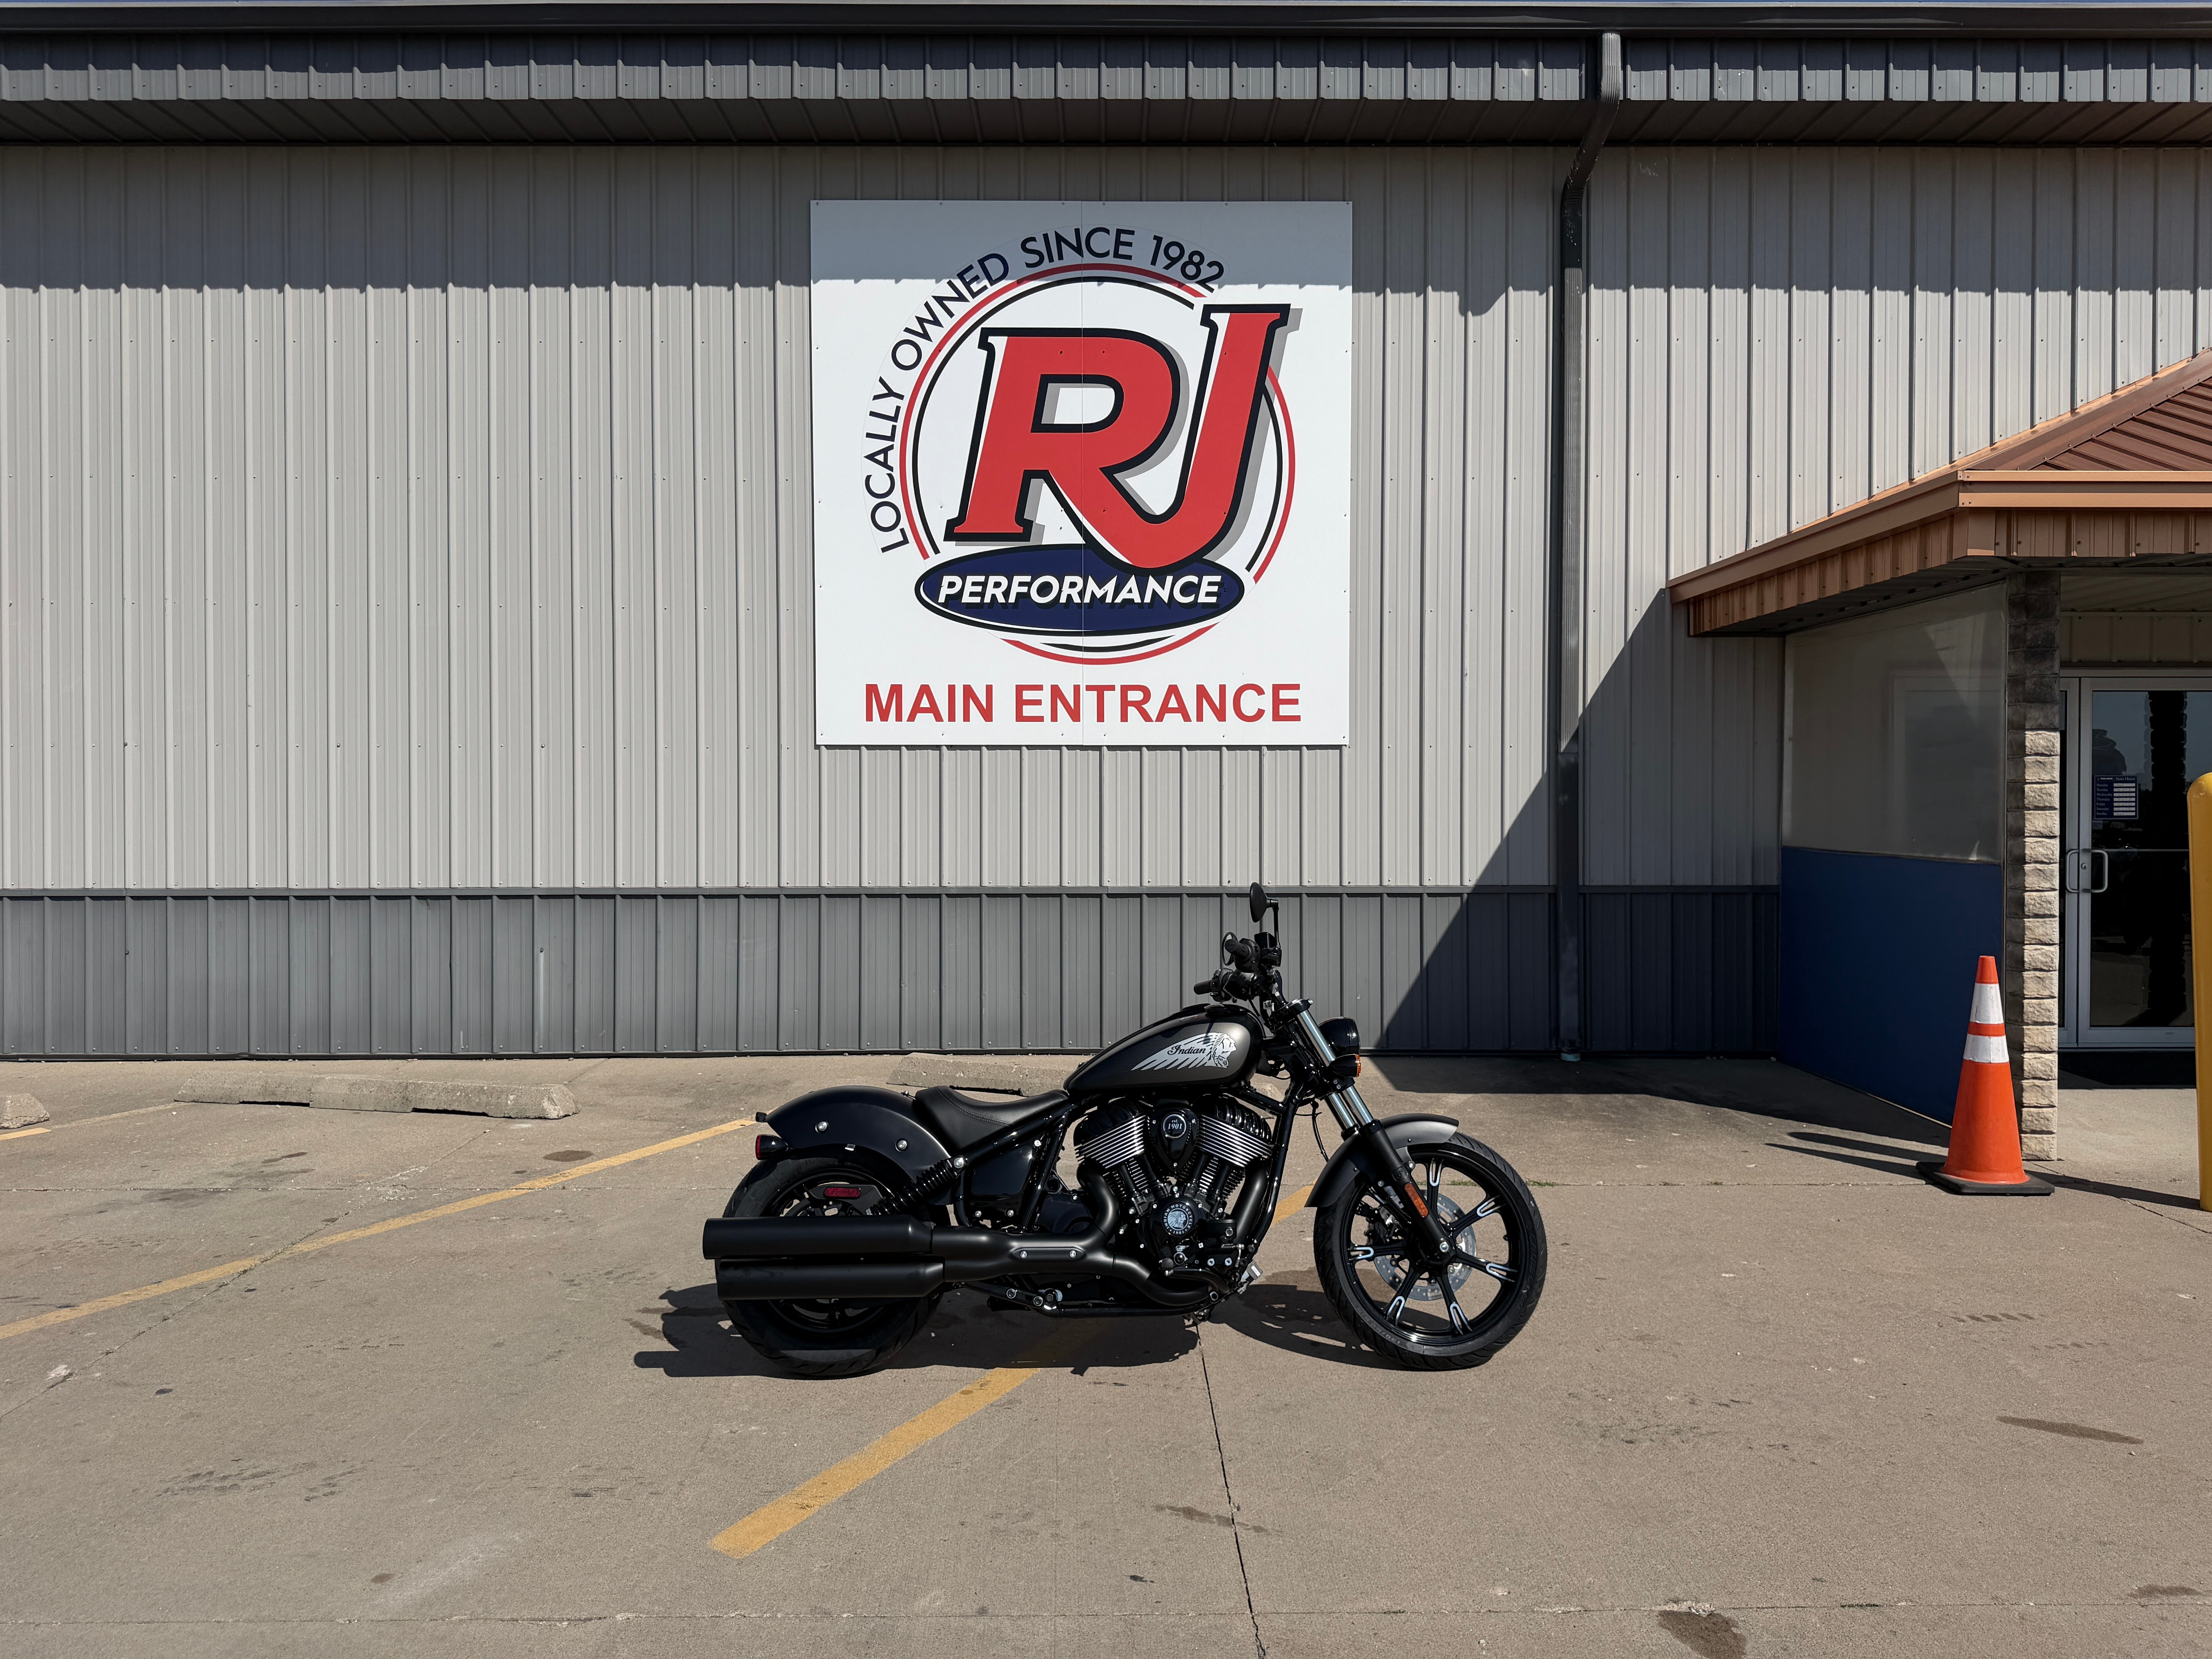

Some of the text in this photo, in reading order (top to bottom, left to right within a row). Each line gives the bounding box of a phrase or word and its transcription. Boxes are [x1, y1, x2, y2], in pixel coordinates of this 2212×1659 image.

[864, 227, 1225, 553] LOCALLY OWNED SINCE 1982
[943, 303, 1291, 575] RJ
[938, 574, 1222, 604] PERFORMANCE
[864, 683, 1302, 723] MAIN ENTRANCE
[1167, 1044, 1206, 1055] Indian
[1171, 1204, 1192, 1229] MOTORCYCLE
